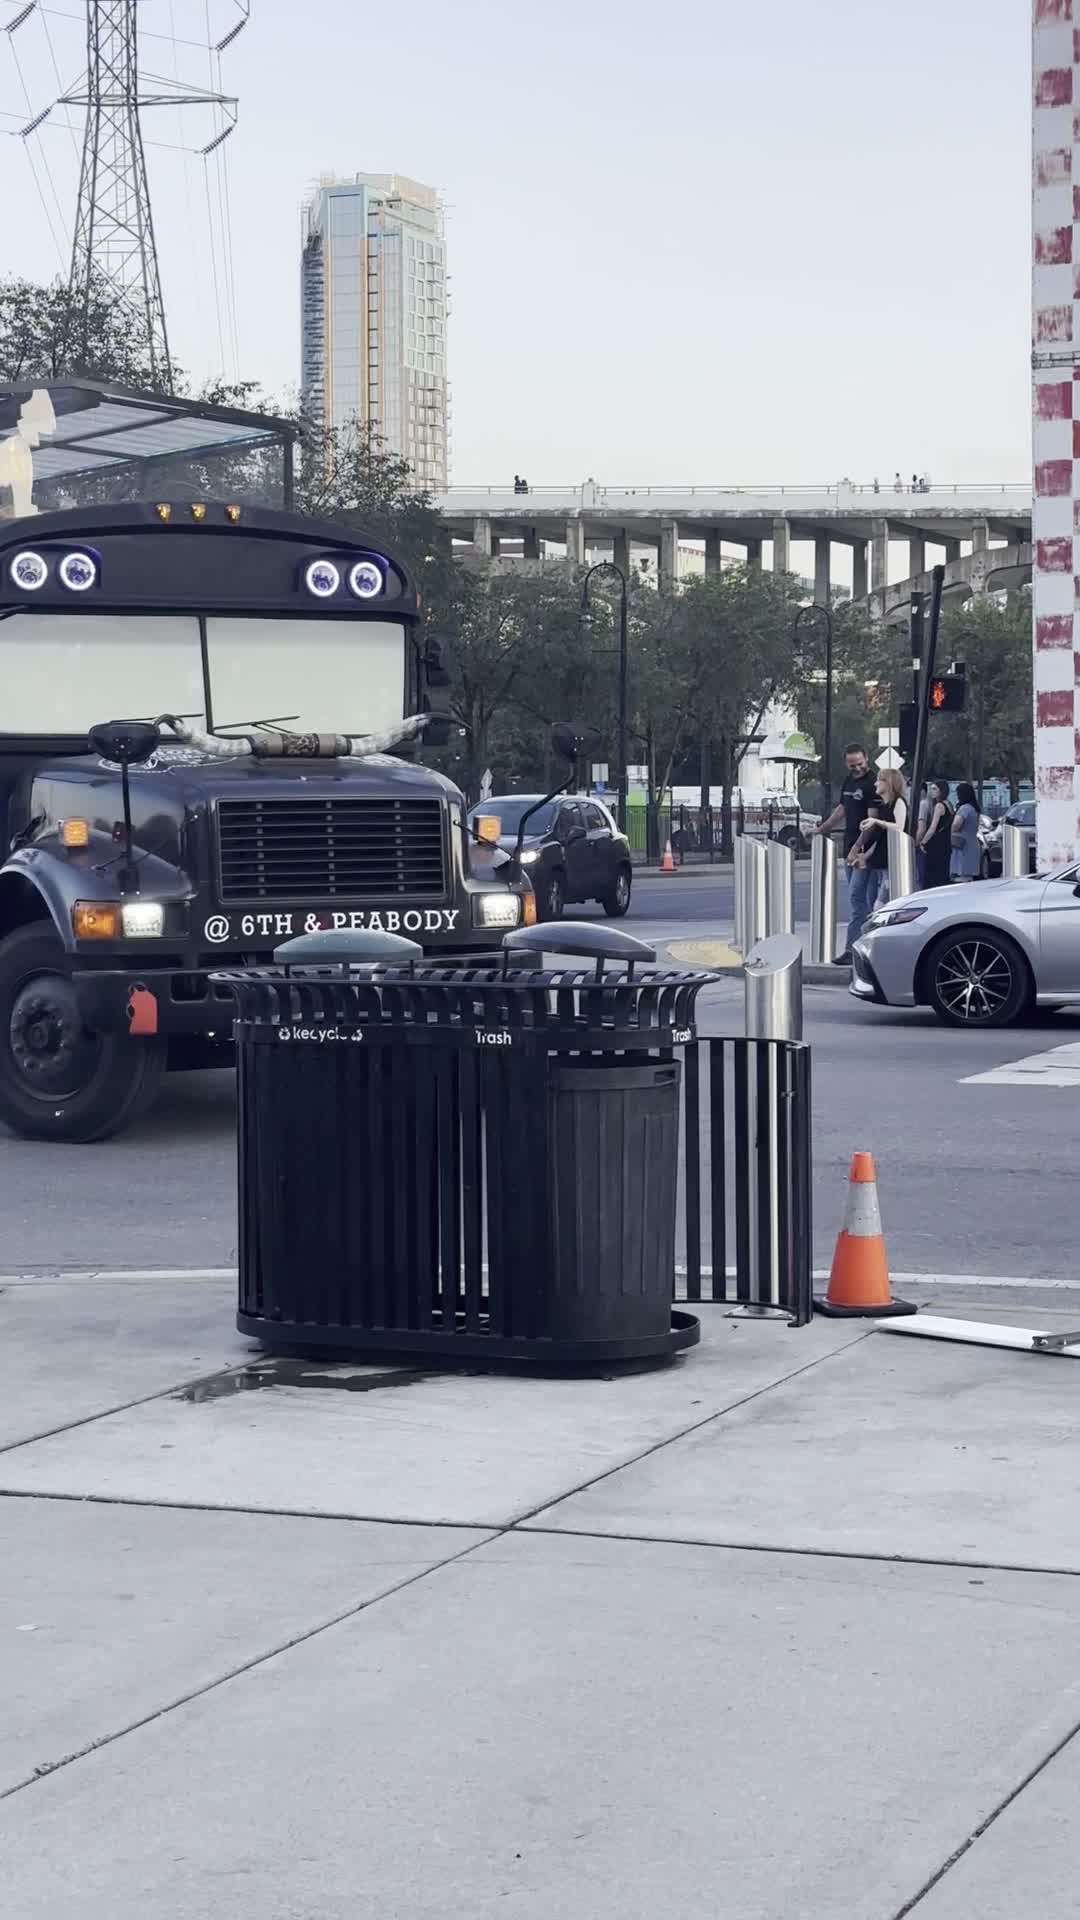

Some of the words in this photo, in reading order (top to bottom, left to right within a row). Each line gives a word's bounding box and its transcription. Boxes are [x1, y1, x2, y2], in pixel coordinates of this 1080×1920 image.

[204, 915, 230, 943] @
[241, 913, 294, 936] 6TH
[303, 913, 322, 933] &
[331, 910, 460, 932] PEABODY
[475, 1030, 512, 1045] Trash
